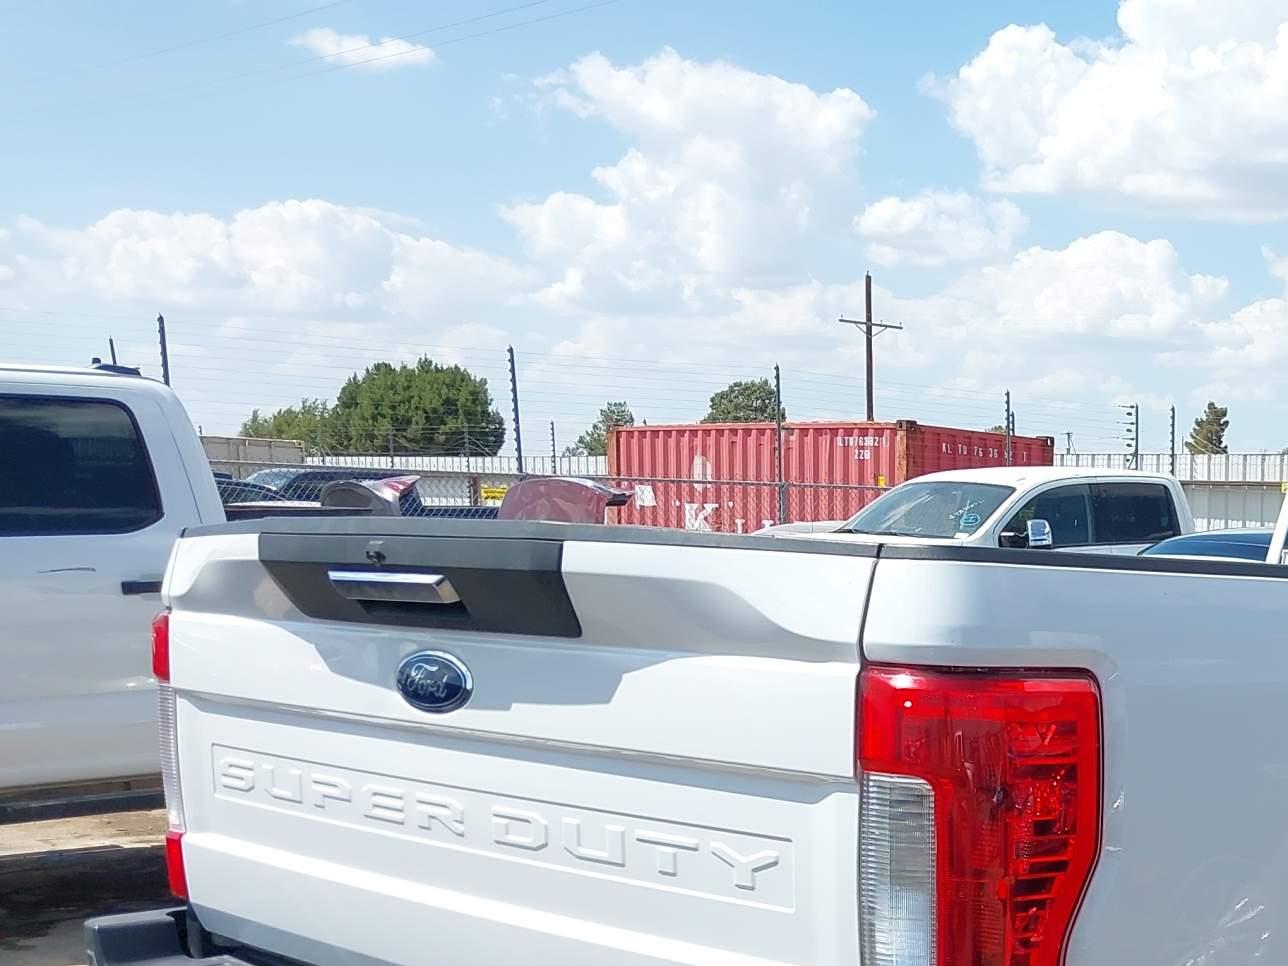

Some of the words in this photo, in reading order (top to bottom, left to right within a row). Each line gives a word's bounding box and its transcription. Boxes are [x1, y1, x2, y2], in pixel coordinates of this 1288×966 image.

[407, 662, 448, 699] Ford
[219, 755, 465, 838] SUPER
[491, 805, 780, 892] DUTY
